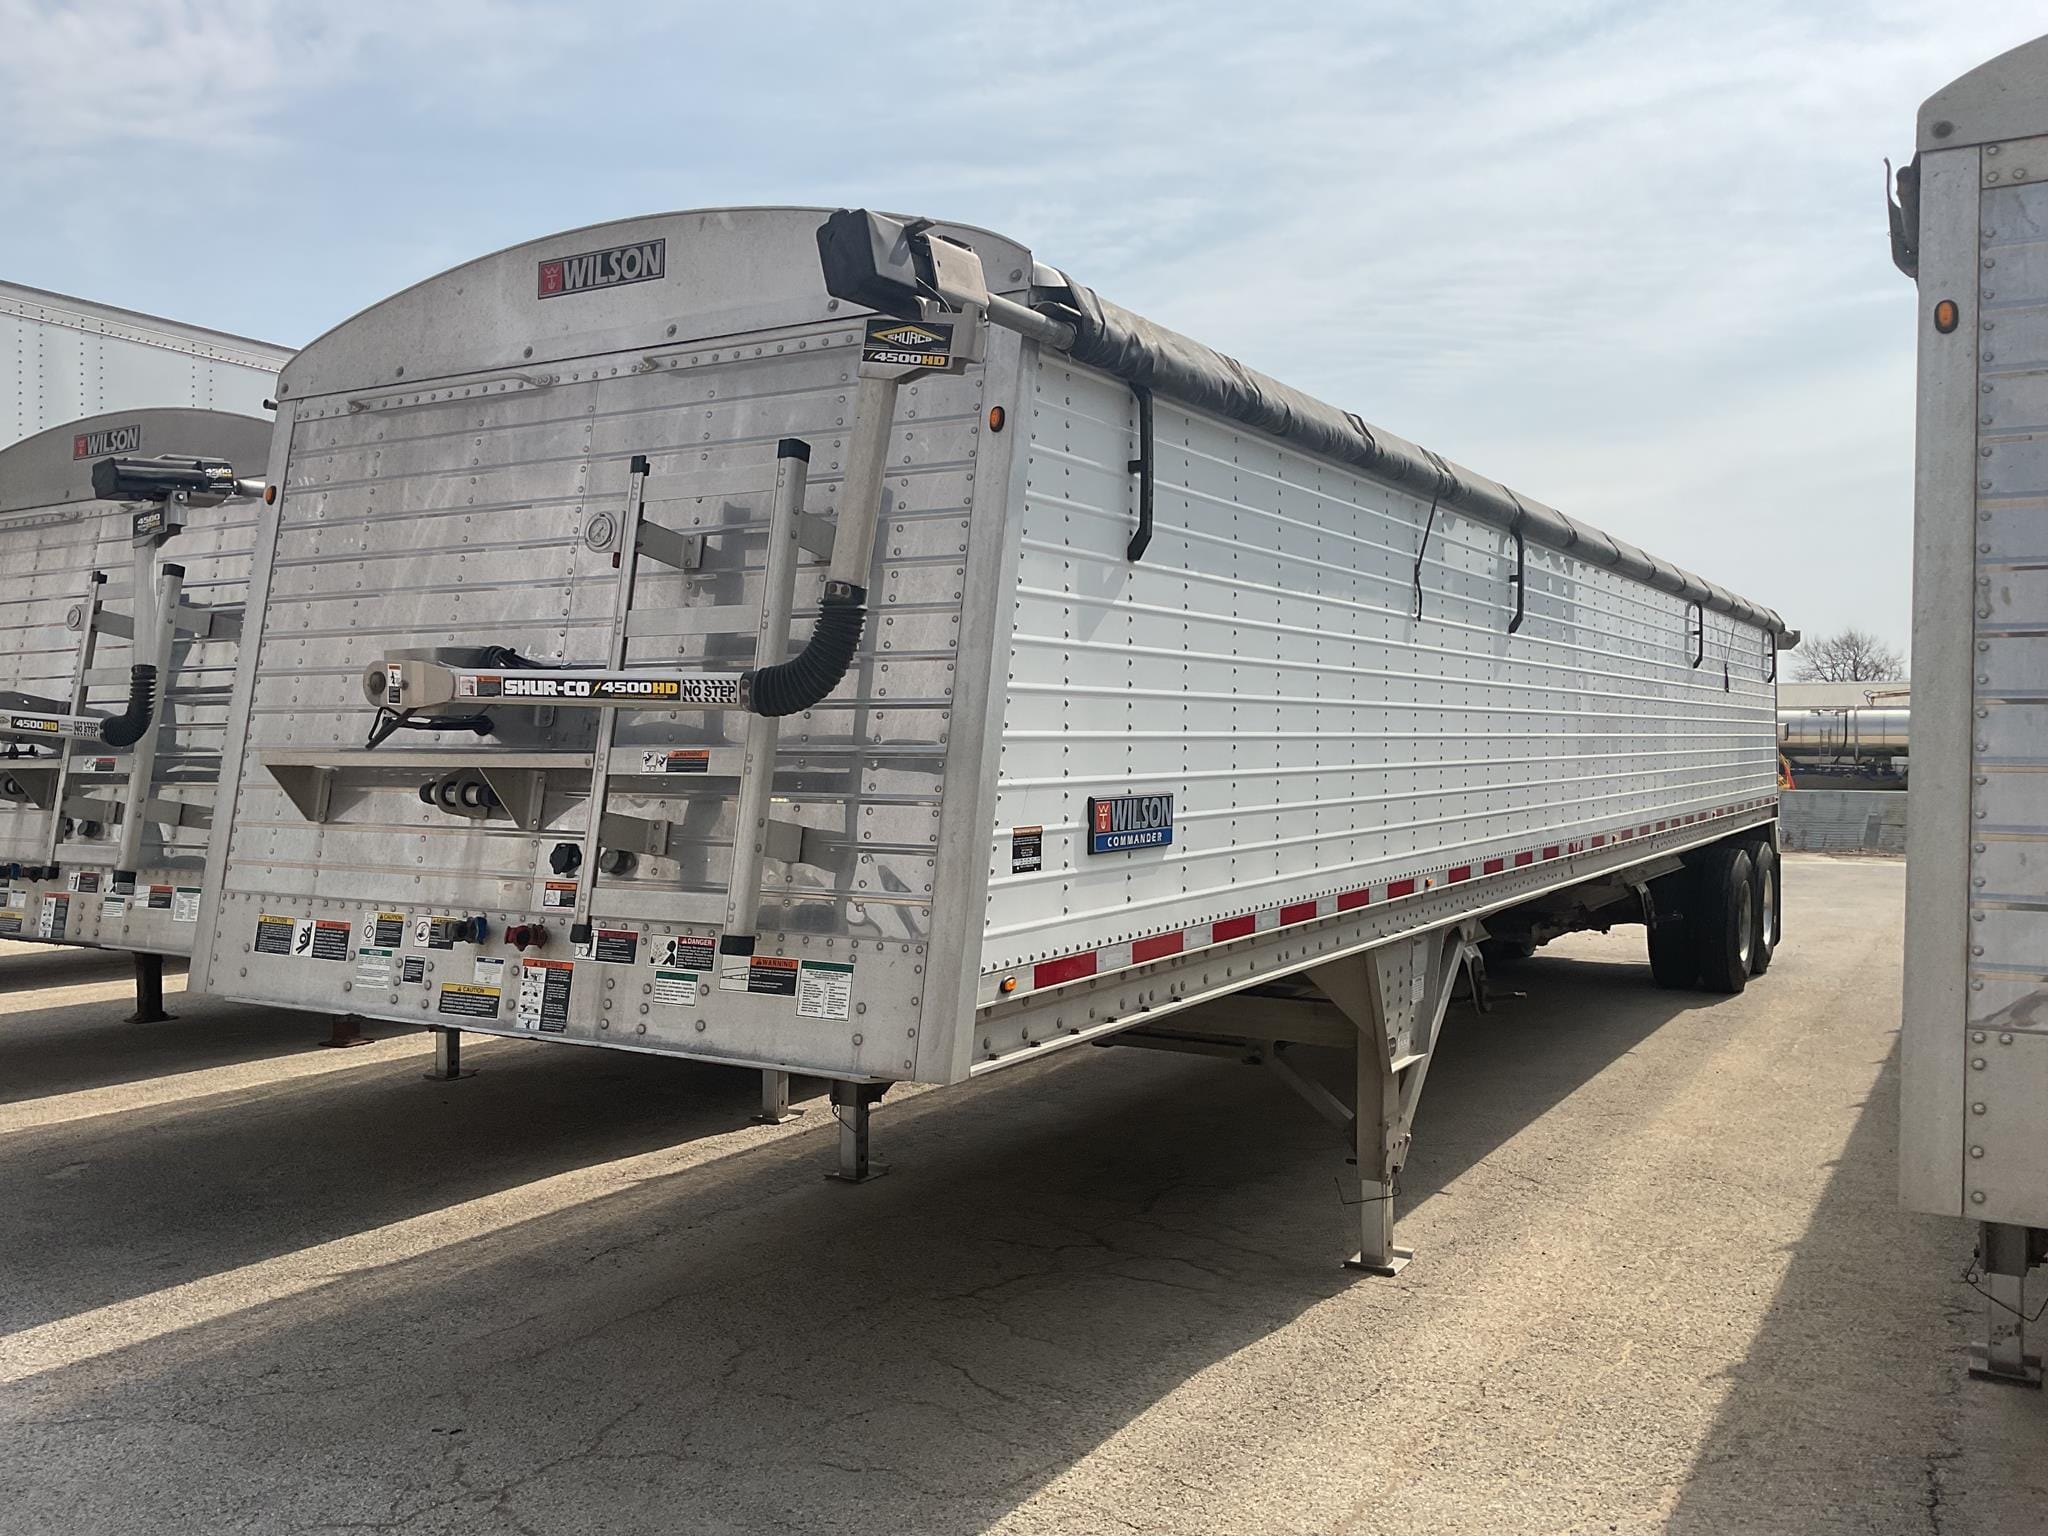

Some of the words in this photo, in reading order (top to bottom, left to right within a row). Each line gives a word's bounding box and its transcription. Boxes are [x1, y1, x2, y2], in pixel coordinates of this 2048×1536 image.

[563, 243, 662, 290] WILSON
[874, 352, 946, 366] 4500HD
[87, 428, 138, 455] WILSON
[504, 680, 590, 697] SHUR-CO
[601, 682, 678, 695] 4500HD
[683, 685, 702, 697] NO
[703, 686, 736, 698] STEP
[15, 719, 58, 731] 4500HD
[1111, 796, 1173, 832] WILSON
[1107, 832, 1163, 848] COMMANDER
[687, 938, 713, 946] DANGER
[761, 959, 794, 968] WARNING
[462, 986, 485, 994] CAUTION
